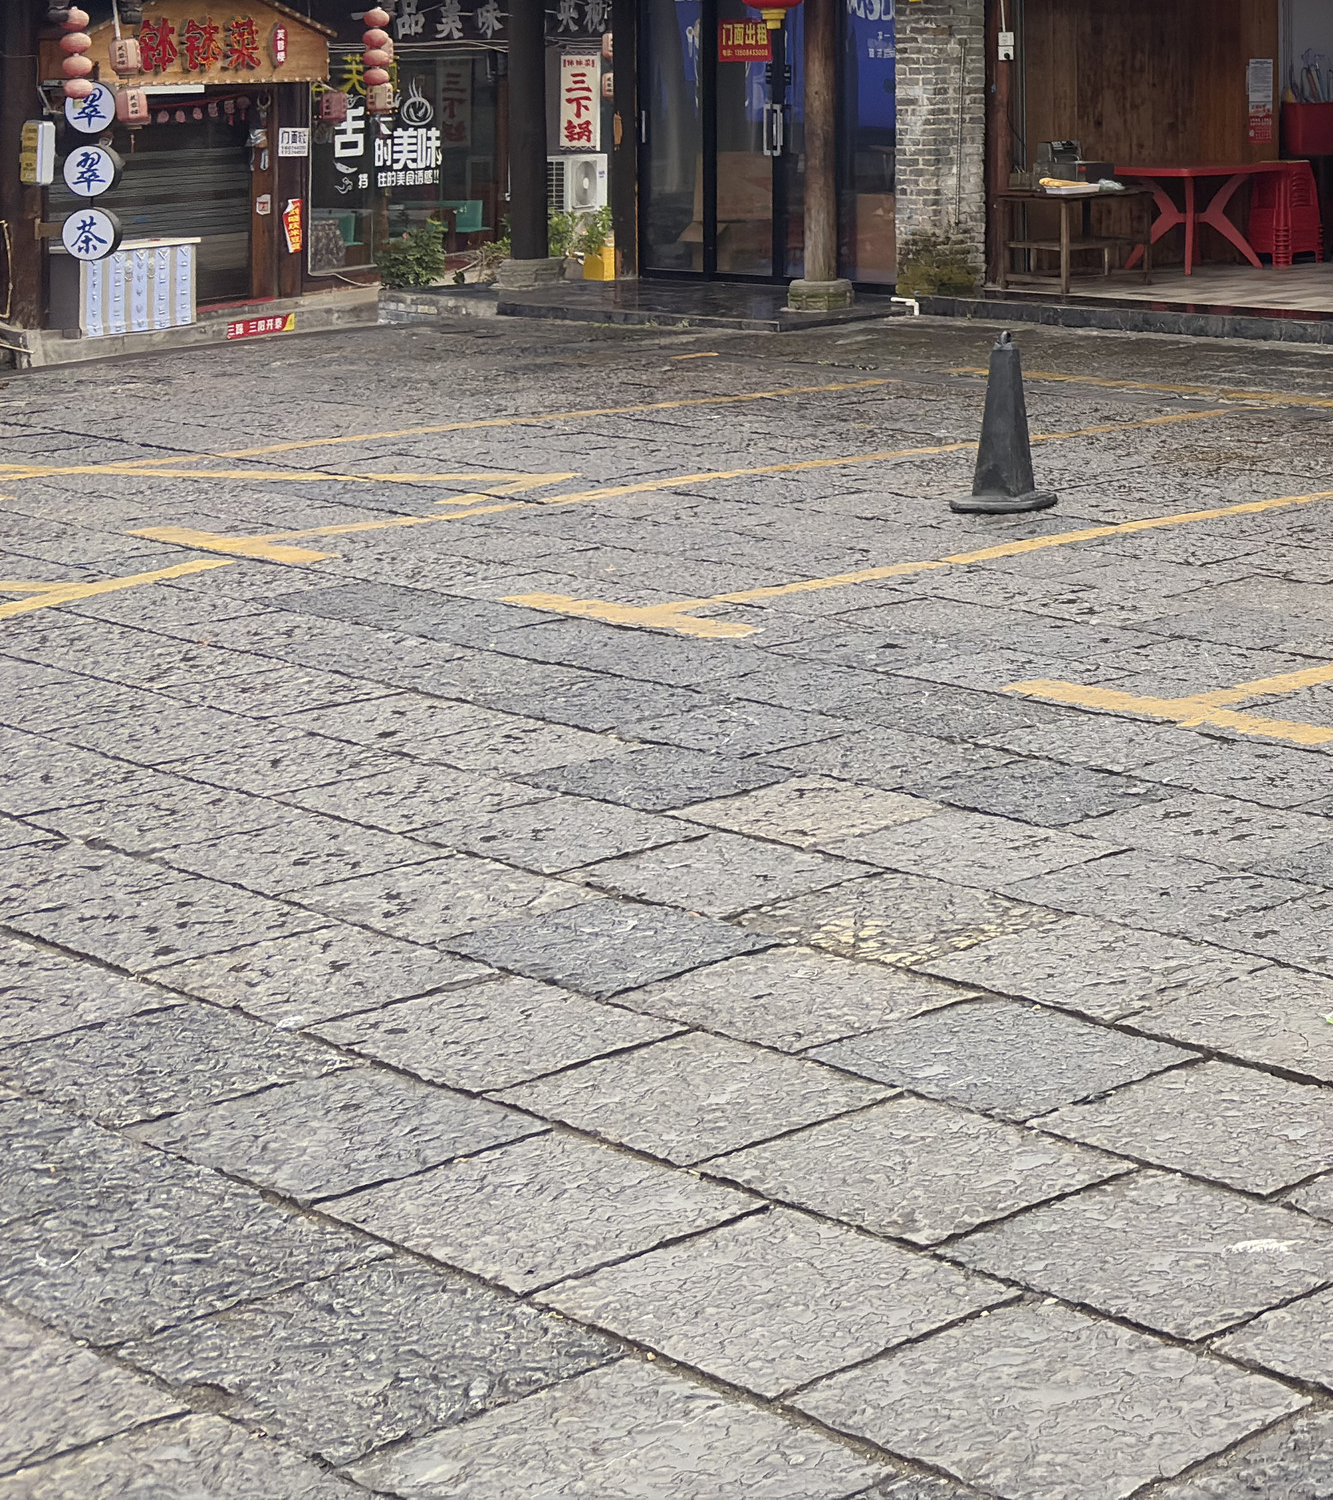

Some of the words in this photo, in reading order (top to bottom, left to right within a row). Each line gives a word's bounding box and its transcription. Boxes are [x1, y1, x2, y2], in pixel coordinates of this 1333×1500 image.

[139, 15, 262, 72] 钵钵菜
[722, 22, 768, 46] 门面出租
[564, 72, 593, 143] 三下锅
